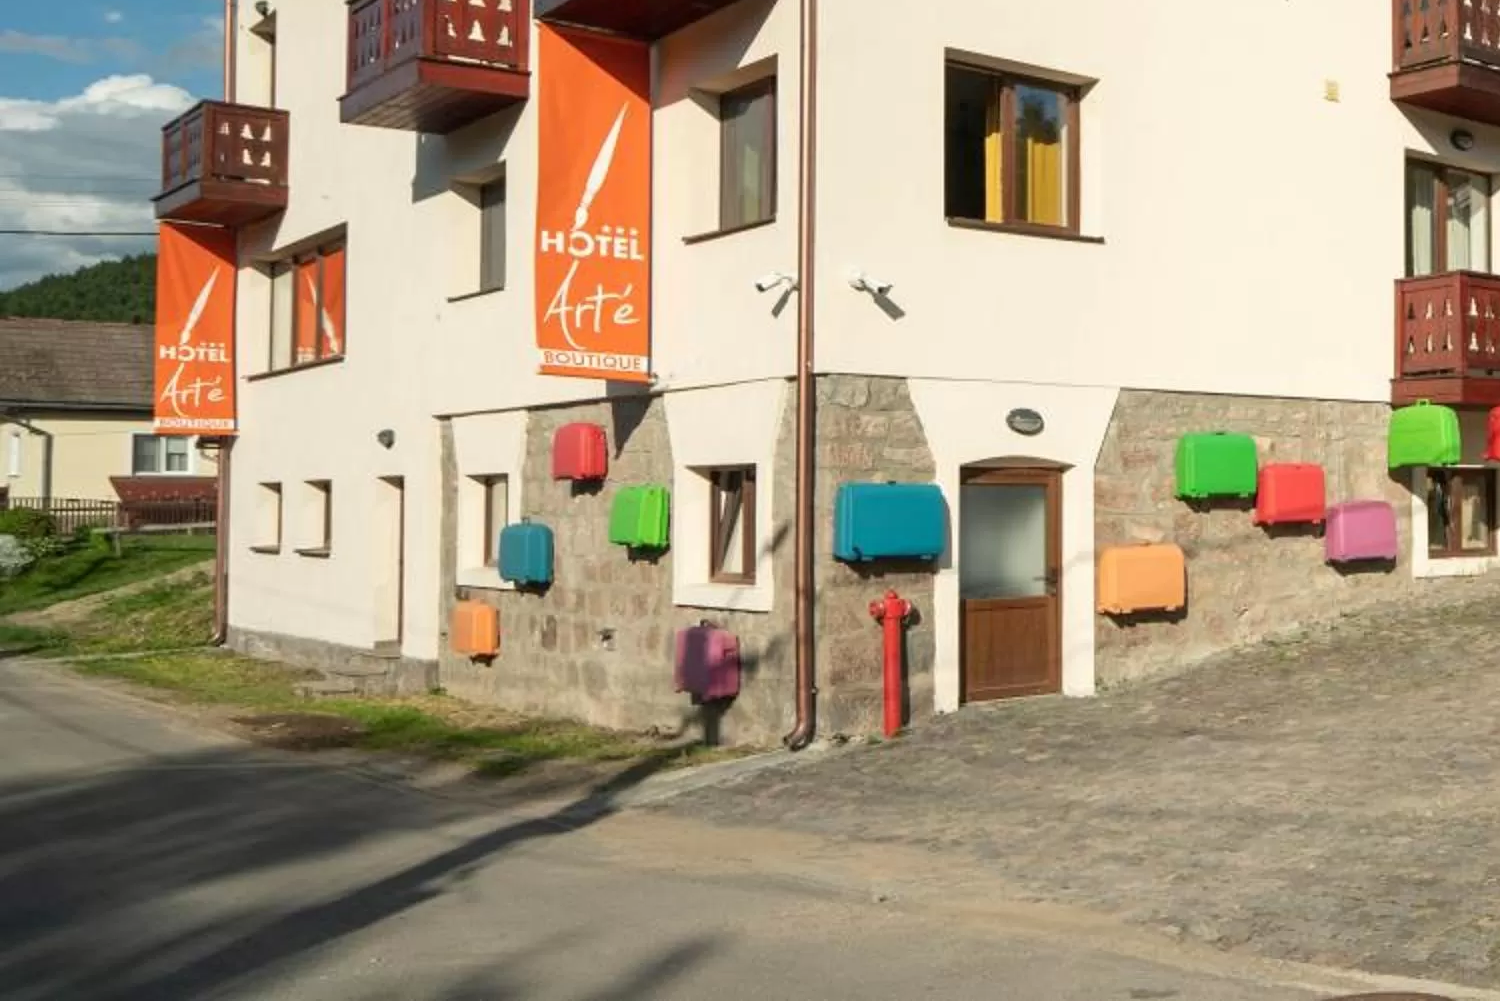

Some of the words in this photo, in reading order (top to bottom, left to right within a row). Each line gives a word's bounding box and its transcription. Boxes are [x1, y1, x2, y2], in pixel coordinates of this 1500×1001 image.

[541, 230, 644, 260] HOTEL
[543, 259, 641, 350] Arté
[159, 344, 230, 362] HOTEL
[543, 351, 642, 370] BOUTIQUE
